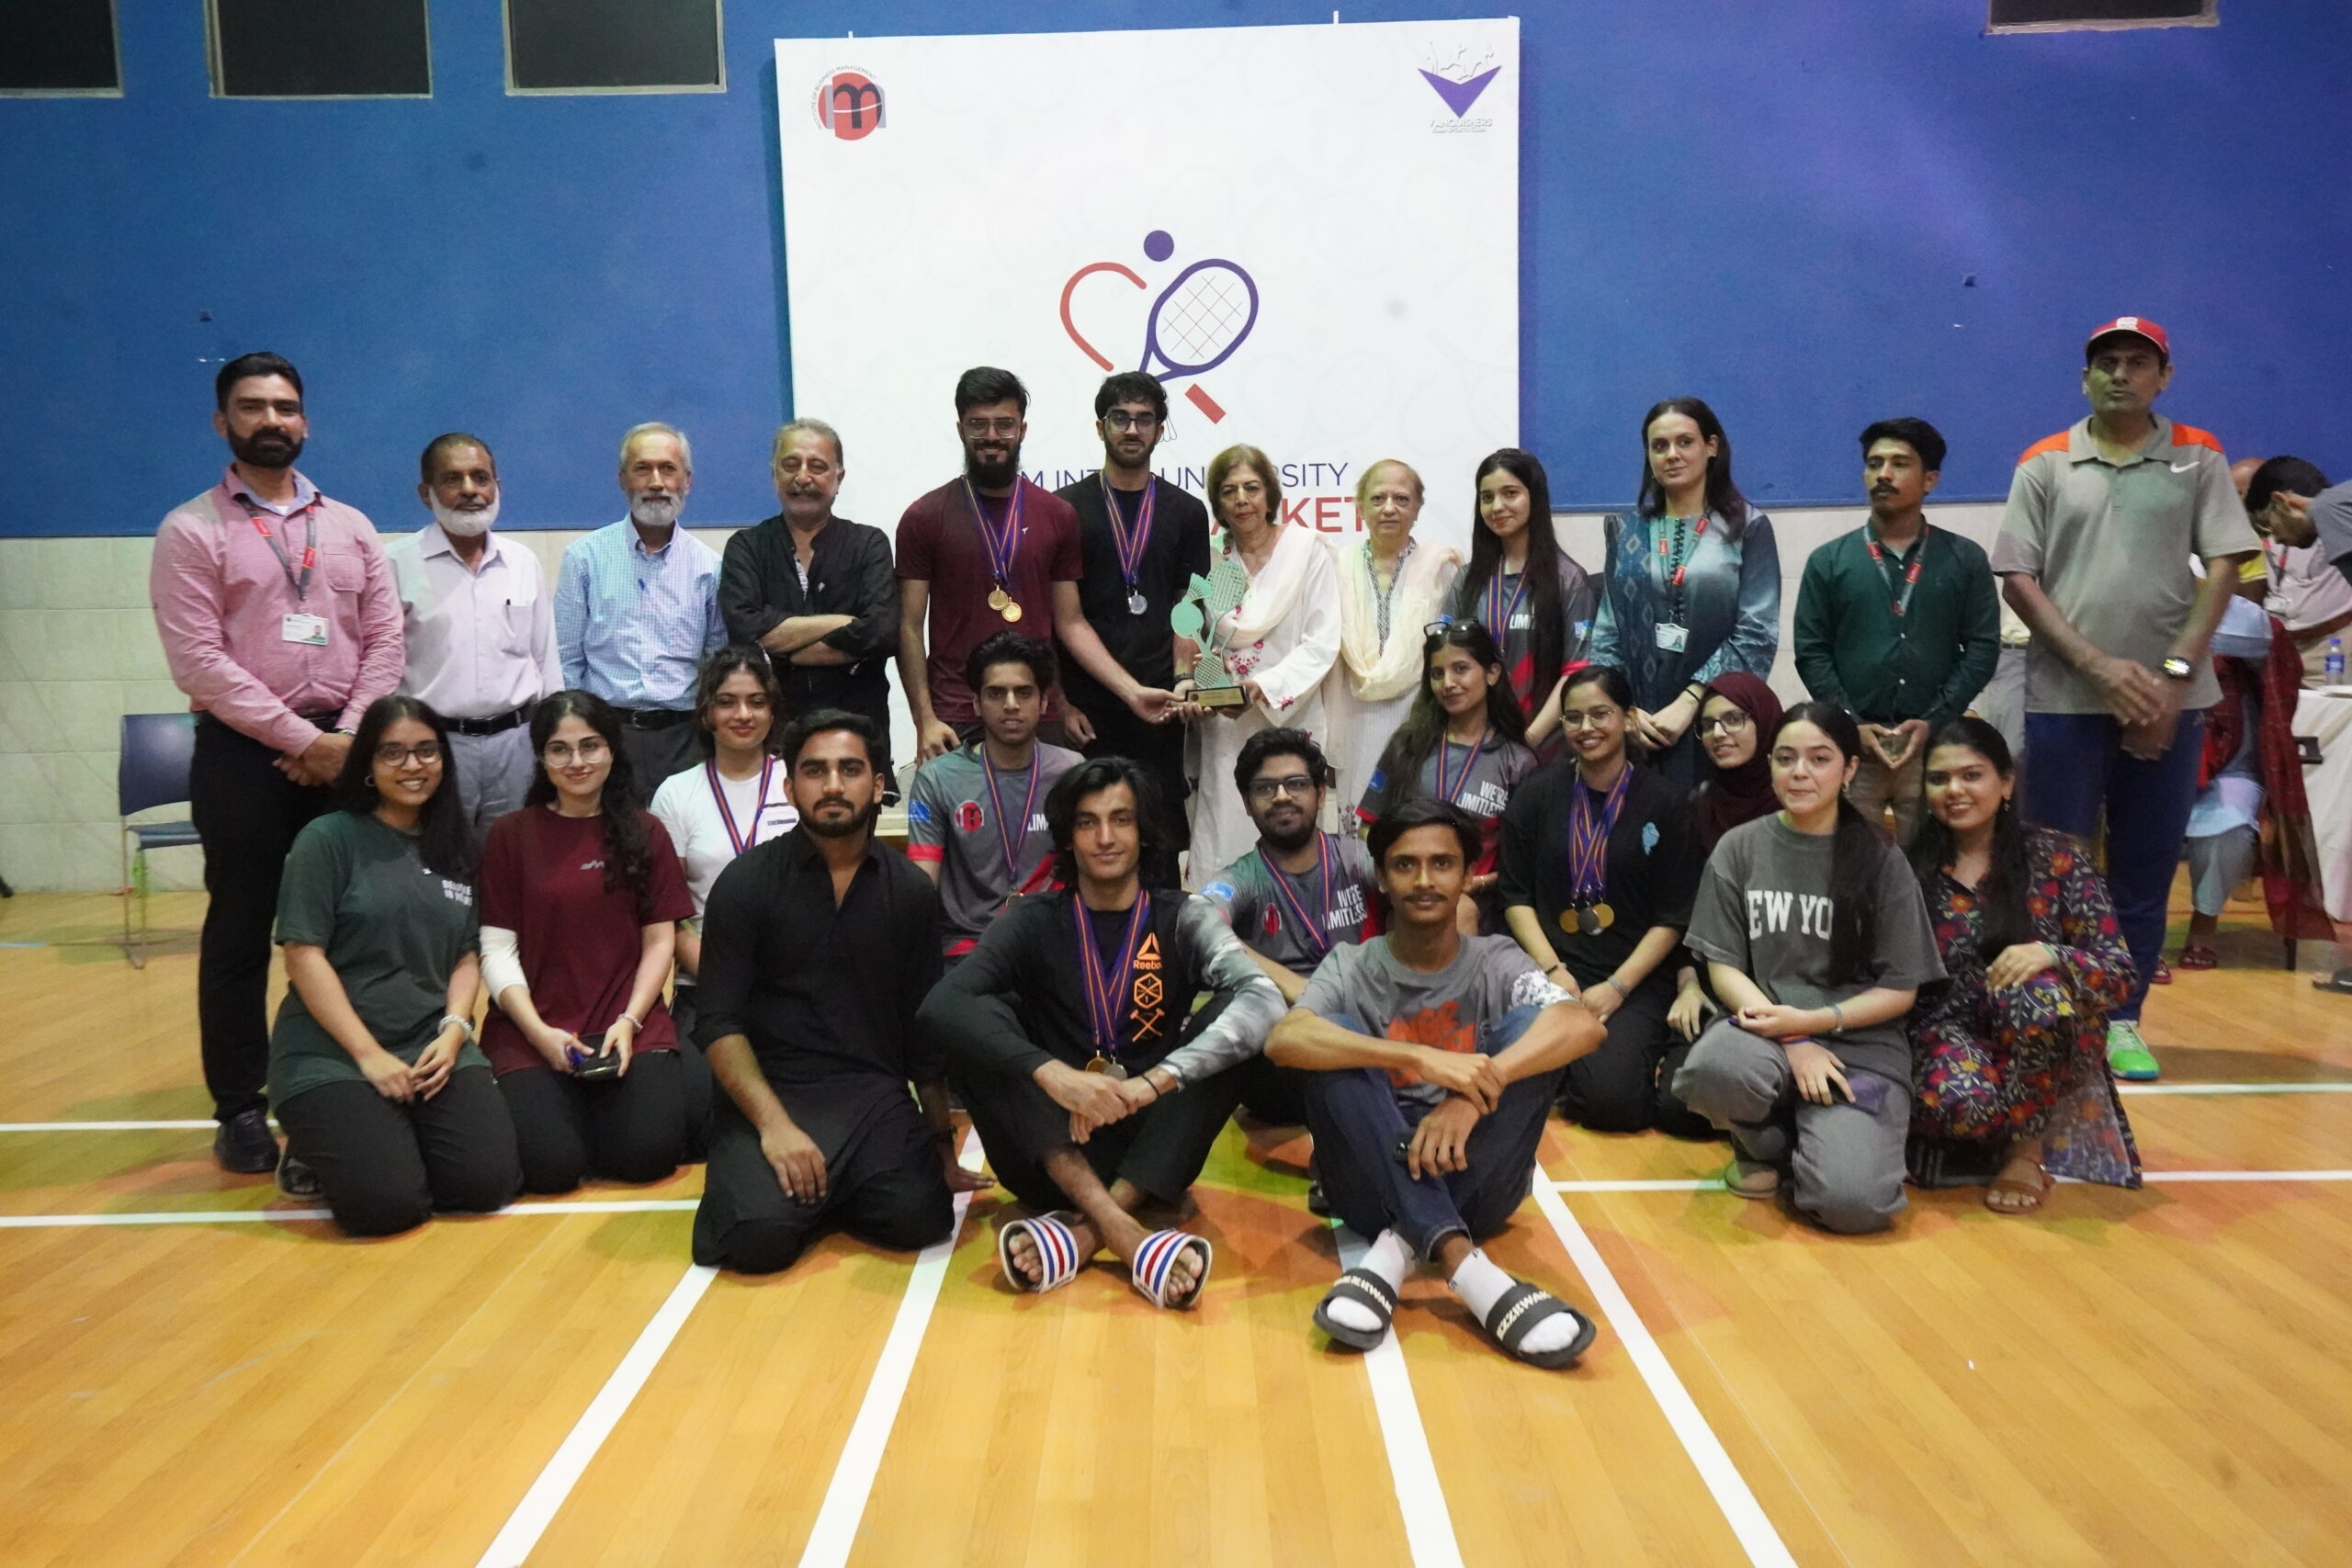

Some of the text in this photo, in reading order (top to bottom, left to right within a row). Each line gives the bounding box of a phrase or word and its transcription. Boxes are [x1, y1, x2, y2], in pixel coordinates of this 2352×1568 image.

[1747, 889, 1834, 941] EW YO
[1133, 959, 1164, 970] Reebo
